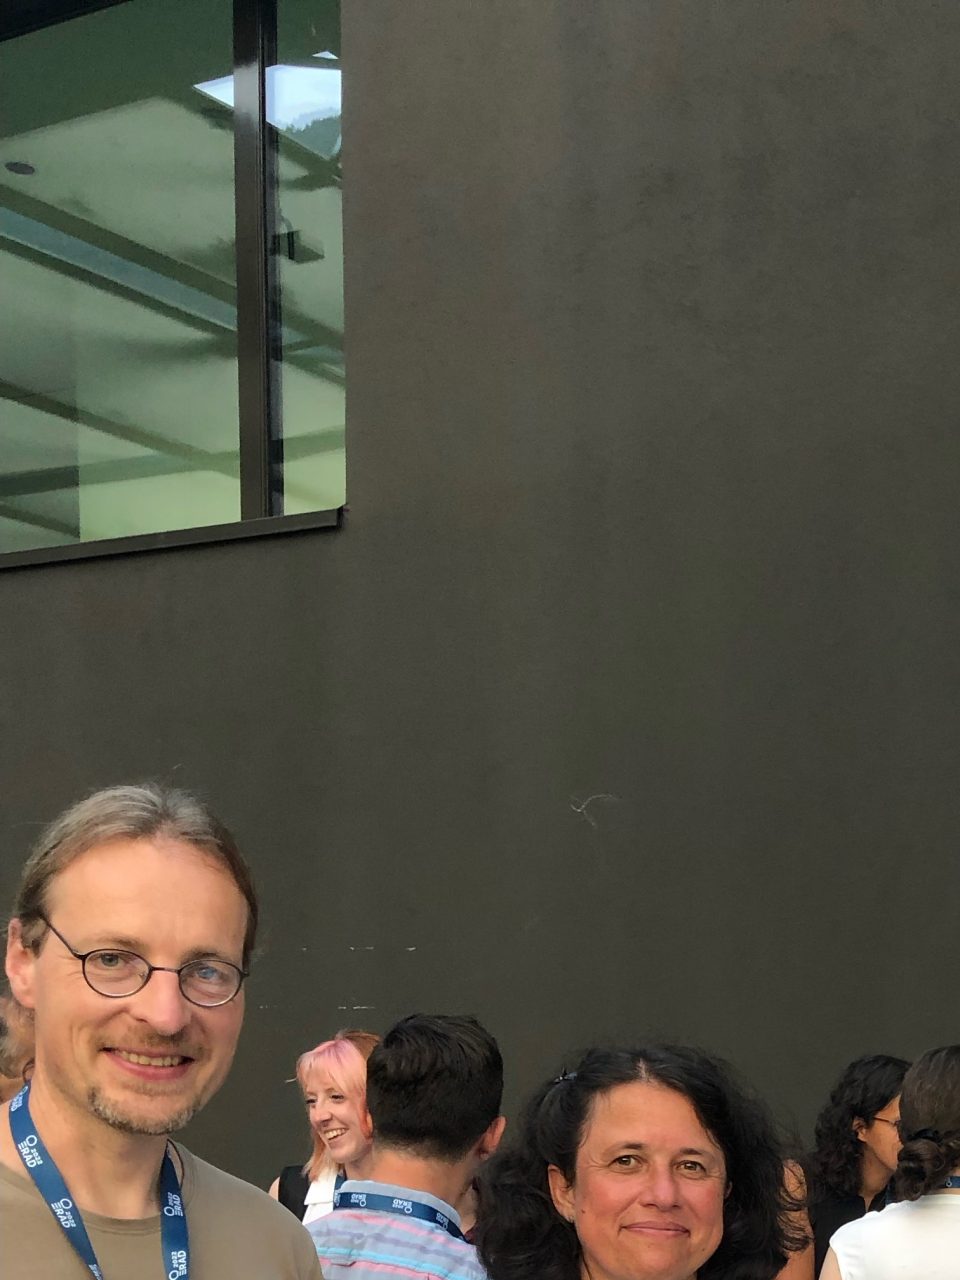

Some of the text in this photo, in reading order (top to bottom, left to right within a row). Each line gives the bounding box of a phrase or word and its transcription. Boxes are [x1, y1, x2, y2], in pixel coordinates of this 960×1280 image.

[18, 1140, 37, 1168] ERAD
[31, 1148, 43, 1166] 2022
[393, 1199, 412, 1208] ERAD
[51, 1201, 71, 1229] ERAD
[65, 1211, 77, 1228] 2022
[177, 1250, 187, 1277] ERAD
